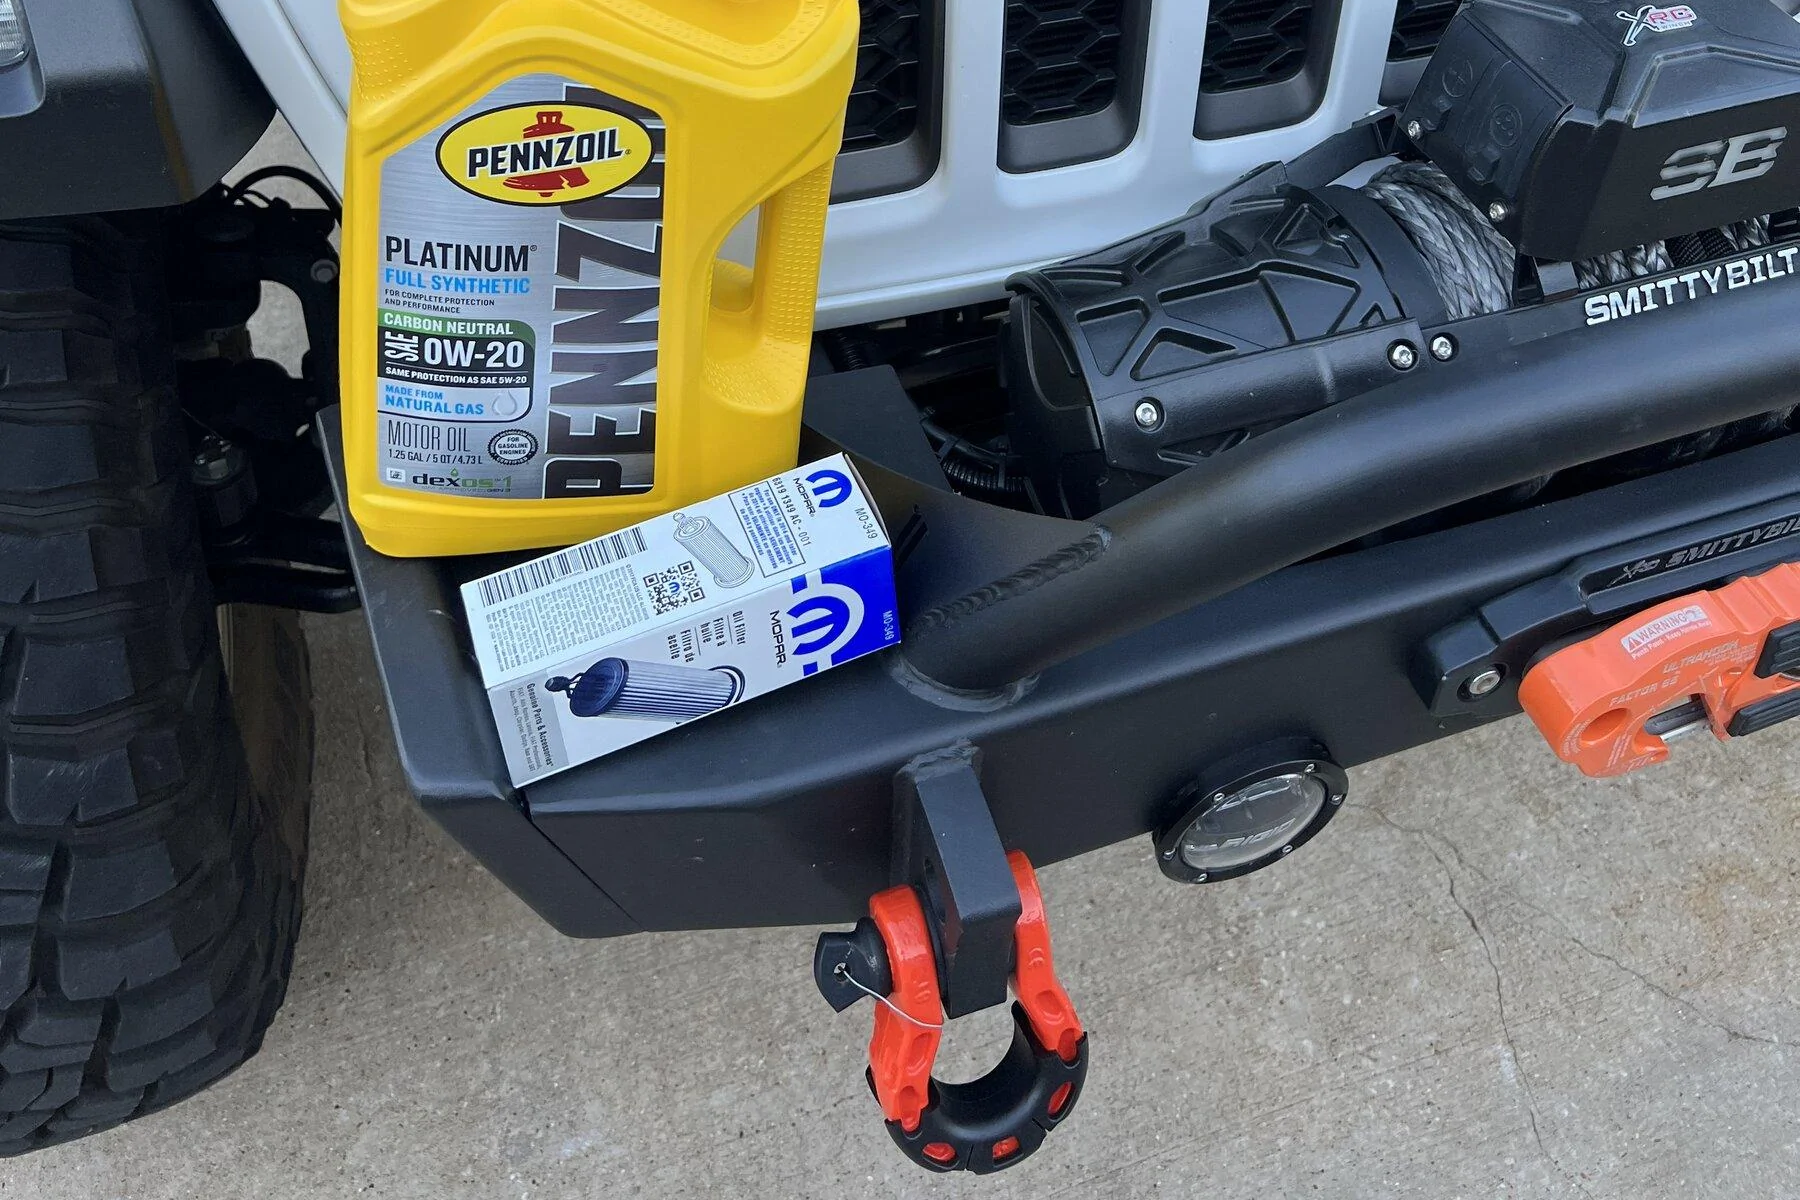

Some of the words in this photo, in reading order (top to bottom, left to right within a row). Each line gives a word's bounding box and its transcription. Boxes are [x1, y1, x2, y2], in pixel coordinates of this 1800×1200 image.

[468, 128, 624, 178] PENNZOIL
[385, 268, 426, 289] FULL
[431, 275, 530, 294] SYNTHETIC
[1585, 247, 1799, 325] SMITTYBILT
[384, 289, 400, 297] FOR
[402, 291, 443, 303] COMPLETE
[445, 297, 495, 306] PROTECTION
[384, 298, 400, 306] AND
[403, 300, 460, 314] PERFORMANCE
[384, 312, 443, 332] CARBON
[446, 321, 514, 335] NEUTRAL
[384, 331, 419, 362] SAE
[424, 337, 525, 368] 0W-20
[385, 366, 410, 378] SAME
[411, 370, 465, 383] PROTECTION
[466, 376, 479, 384] AS
[481, 376, 498, 384] SAE
[498, 376, 527, 384] 5W-20
[385, 384, 413, 396] MADE
[415, 389, 443, 400] FROM
[385, 395, 453, 414] NATURAL
[455, 403, 484, 415] GAS
[388, 420, 440, 451] MOTOR
[447, 427, 471, 452] OIL
[389, 449, 406, 460] 1.25
[407, 451, 424, 462] GAL
[433, 455, 438, 464] 5
[478, 455, 483, 465] L
[794, 478, 814, 513] MOPAR
[782, 496, 794, 511] 1349
[791, 514, 800, 524] AC
[855, 508, 877, 538] MO-349
[733, 611, 742, 622] Oil
[883, 611, 893, 639] MO-349
[1636, 611, 1688, 642] WARNING
[701, 622, 711, 642] huile
[714, 618, 724, 639] Filtre
[735, 623, 746, 644] Filter
[770, 611, 785, 664] MOPAR
[668, 634, 679, 659] aceite
[681, 630, 692, 651] Filtro
[685, 652, 694, 662] de
[1609, 683, 1658, 708] FACTOR
[533, 709, 543, 723] Parts
